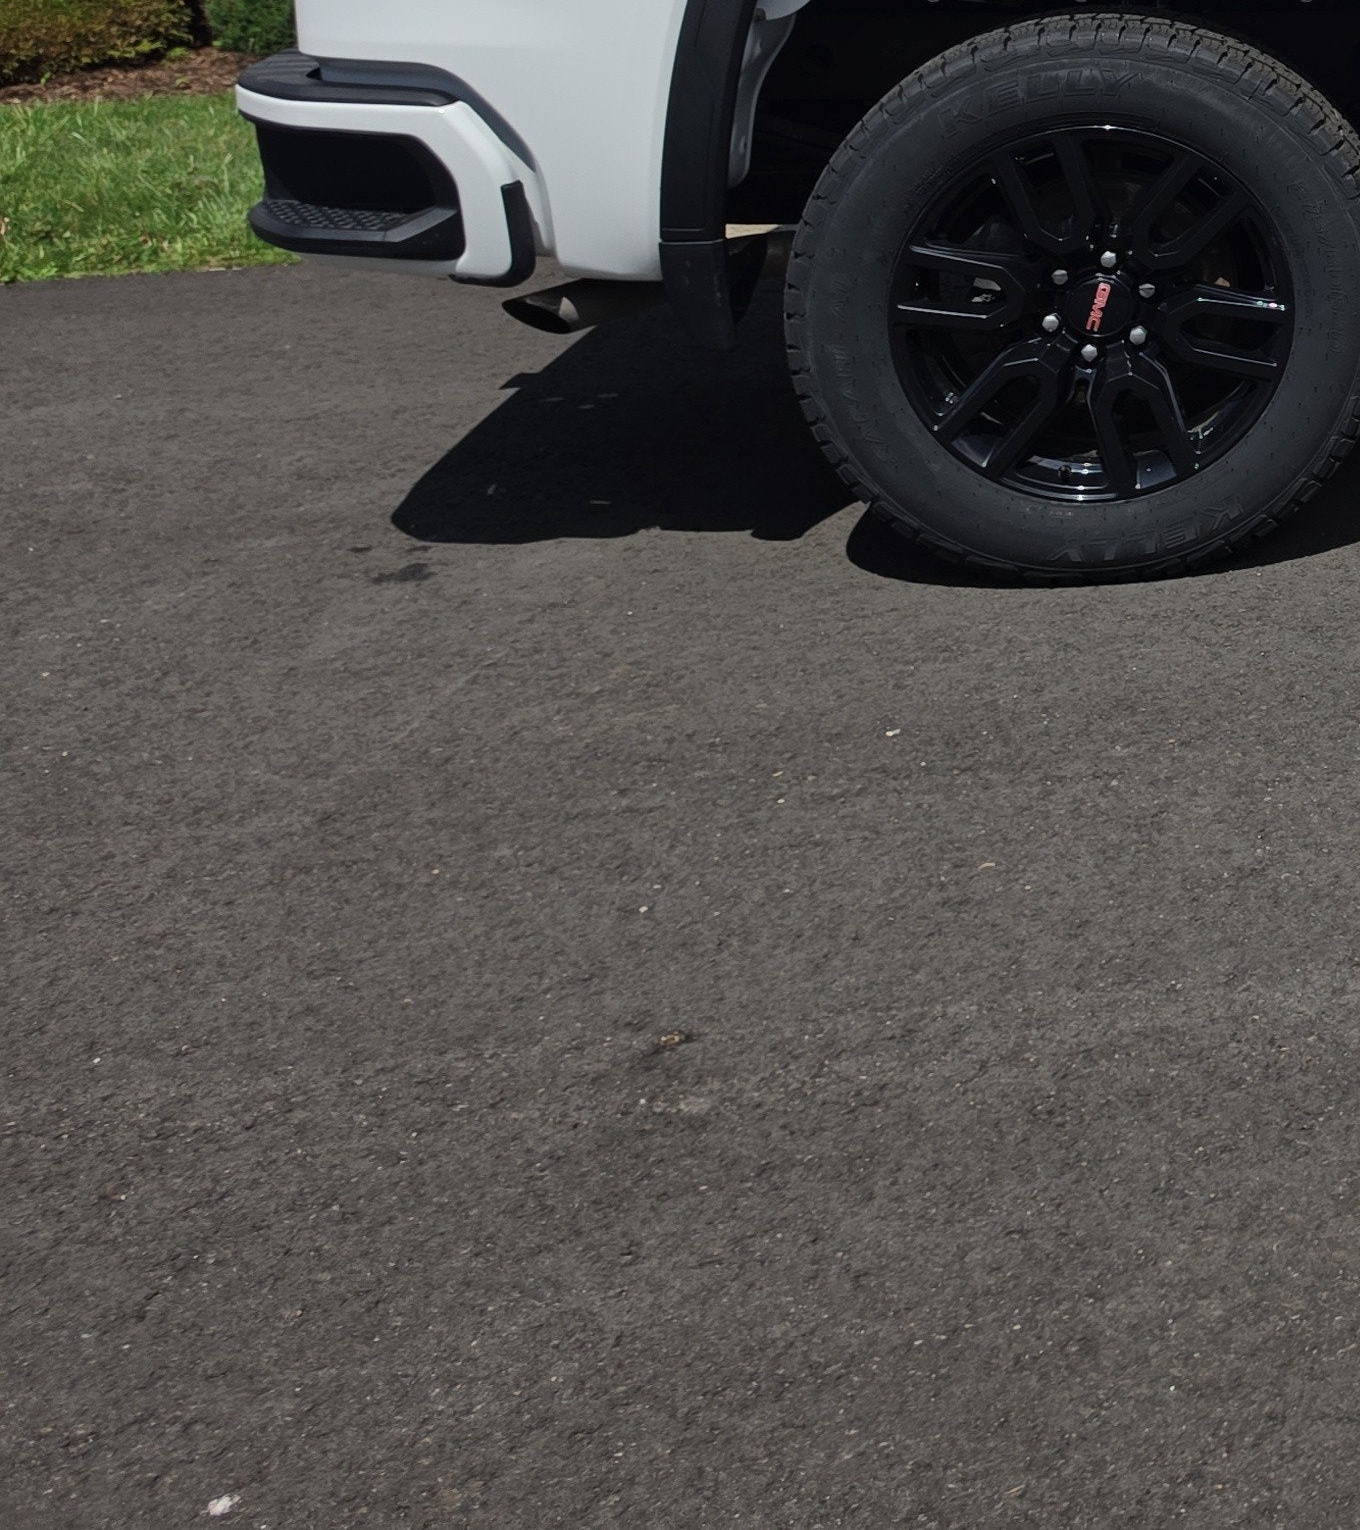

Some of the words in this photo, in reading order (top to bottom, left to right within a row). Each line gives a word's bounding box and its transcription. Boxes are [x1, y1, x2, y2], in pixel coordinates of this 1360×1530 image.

[937, 66, 1143, 138] KELLY
[1085, 283, 1112, 332] GMC
[1048, 496, 1246, 566] KELLY
